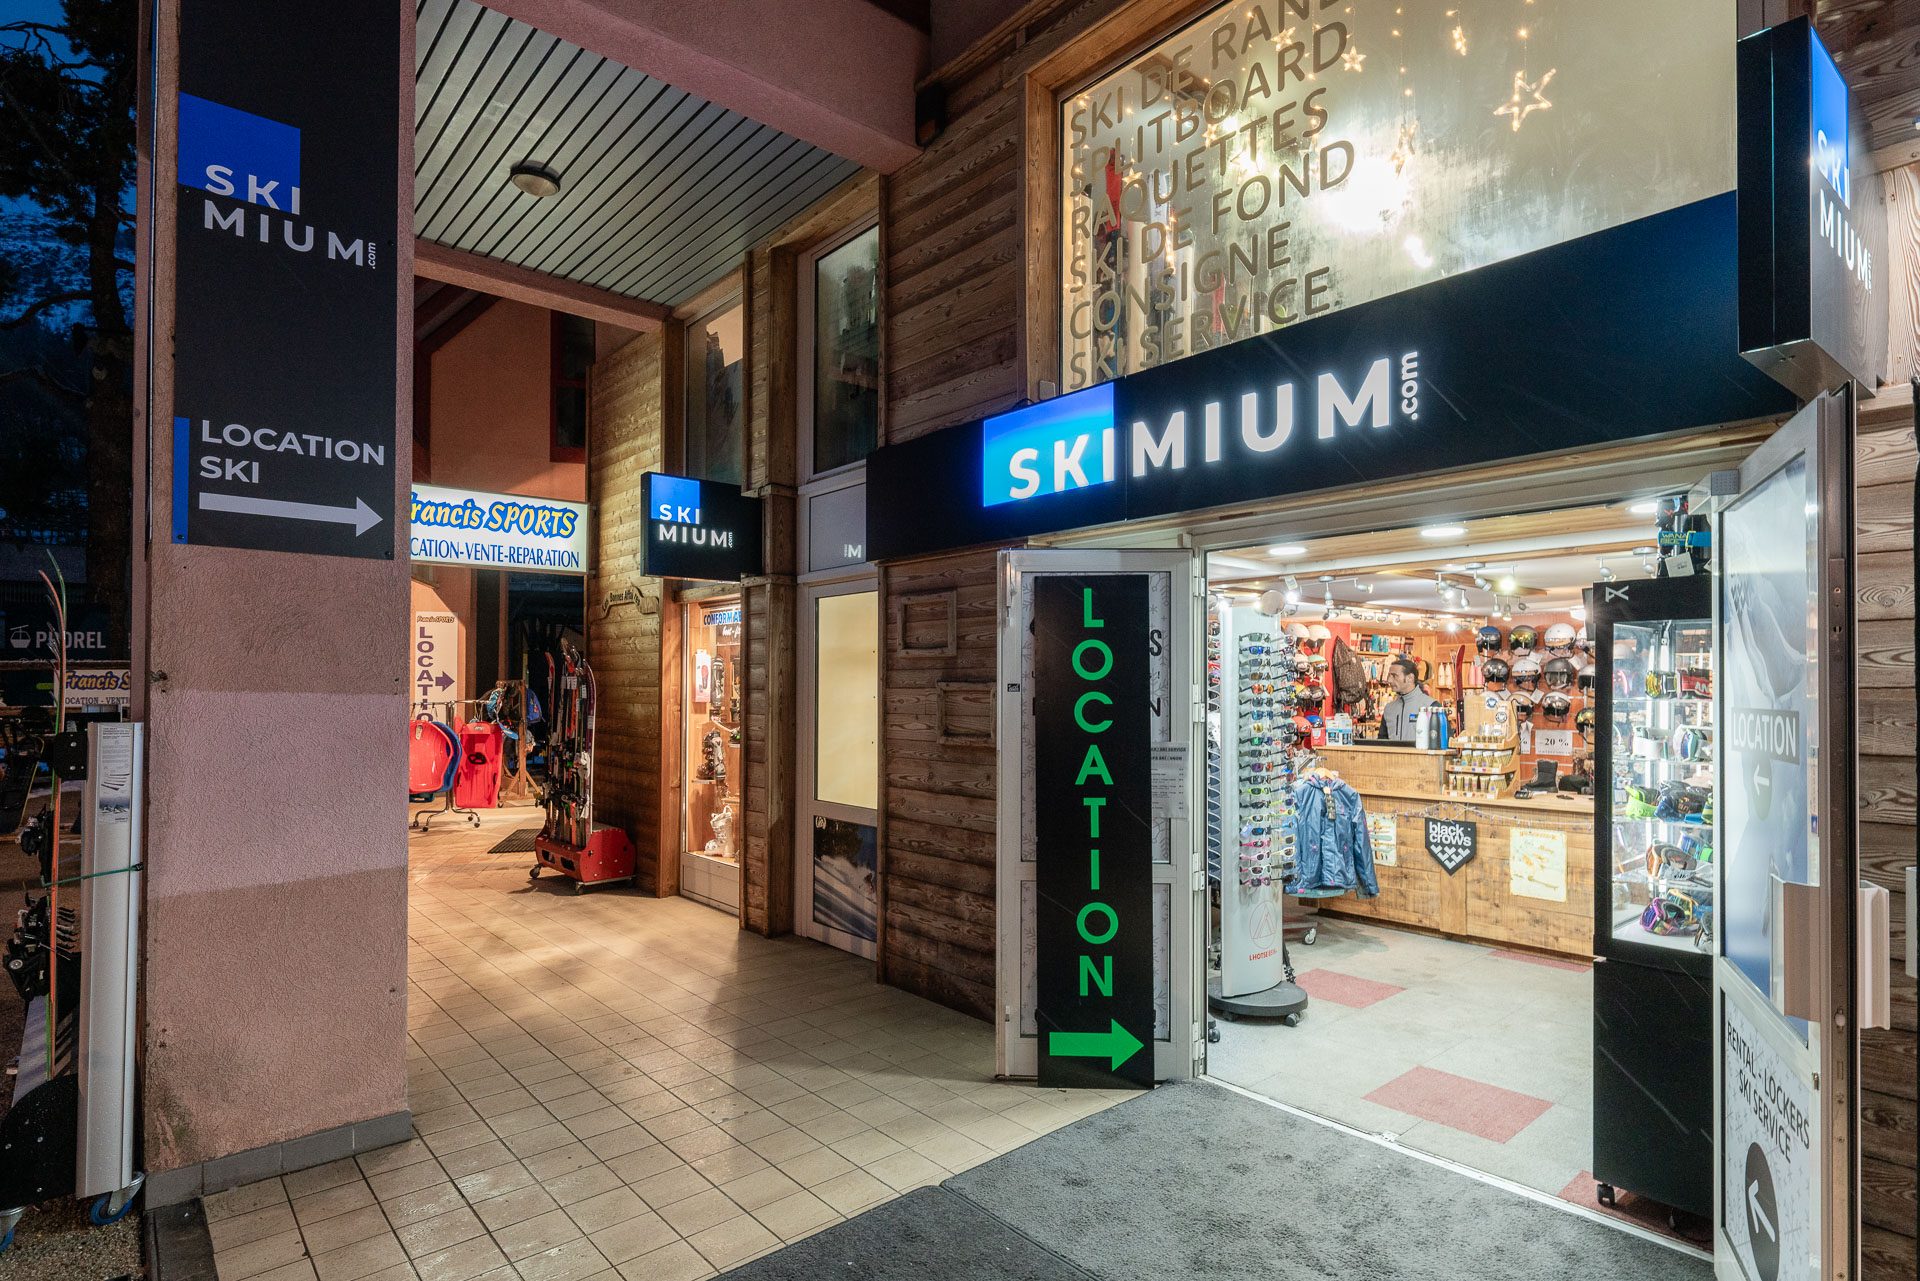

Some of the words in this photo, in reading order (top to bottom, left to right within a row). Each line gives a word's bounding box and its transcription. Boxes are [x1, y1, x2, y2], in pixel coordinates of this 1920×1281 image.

[1070, 87, 1123, 149] SKI
[1141, 45, 1193, 110] DE
[1212, 0, 1339, 69] RAN
[1070, 21, 1347, 198] SPLITBOARD
[204, 164, 300, 216] SKI
[1071, 87, 1329, 246] RAQUETTES
[1817, 130, 1850, 210] SKI
[203, 199, 364, 267] MIUM
[1070, 236, 1123, 294] SKI
[1141, 207, 1193, 264] DE
[1212, 140, 1355, 235] FOND
[1820, 188, 1869, 291] MIUM
[368, 242, 377, 270] .com
[1070, 221, 1291, 339] CONSIGNE
[1070, 336, 1126, 389] SKI
[1140, 266, 1330, 368] SERVICE
[1400, 351, 1419, 421] .com
[200, 456, 260, 484] SKI
[202, 420, 385, 466] LOCATION
[411, 492, 484, 529] rancis
[485, 502, 577, 537] SPORTS
[659, 504, 700, 525] SKI
[659, 524, 727, 548] MIUM
[411, 538, 580, 568] CATION-VENTE-REPARATION
[65, 670, 119, 690] Francis
[65, 697, 99, 705] OCATION
[106, 697, 129, 705] VENT
[417, 626, 434, 722] LOCATIO
[1544, 737, 1556, 746] 20
[1733, 712, 1797, 759] LOCATION
[1072, 588, 1119, 997] LOCATION
[1429, 821, 1464, 837] black
[1430, 832, 1472, 847] crows
[1726, 1020, 1756, 1079] RENTAL
[1764, 1068, 1810, 1150] LOCKERS
[1739, 1070, 1752, 1107] SKI
[1753, 1092, 1792, 1164] SERVICE
